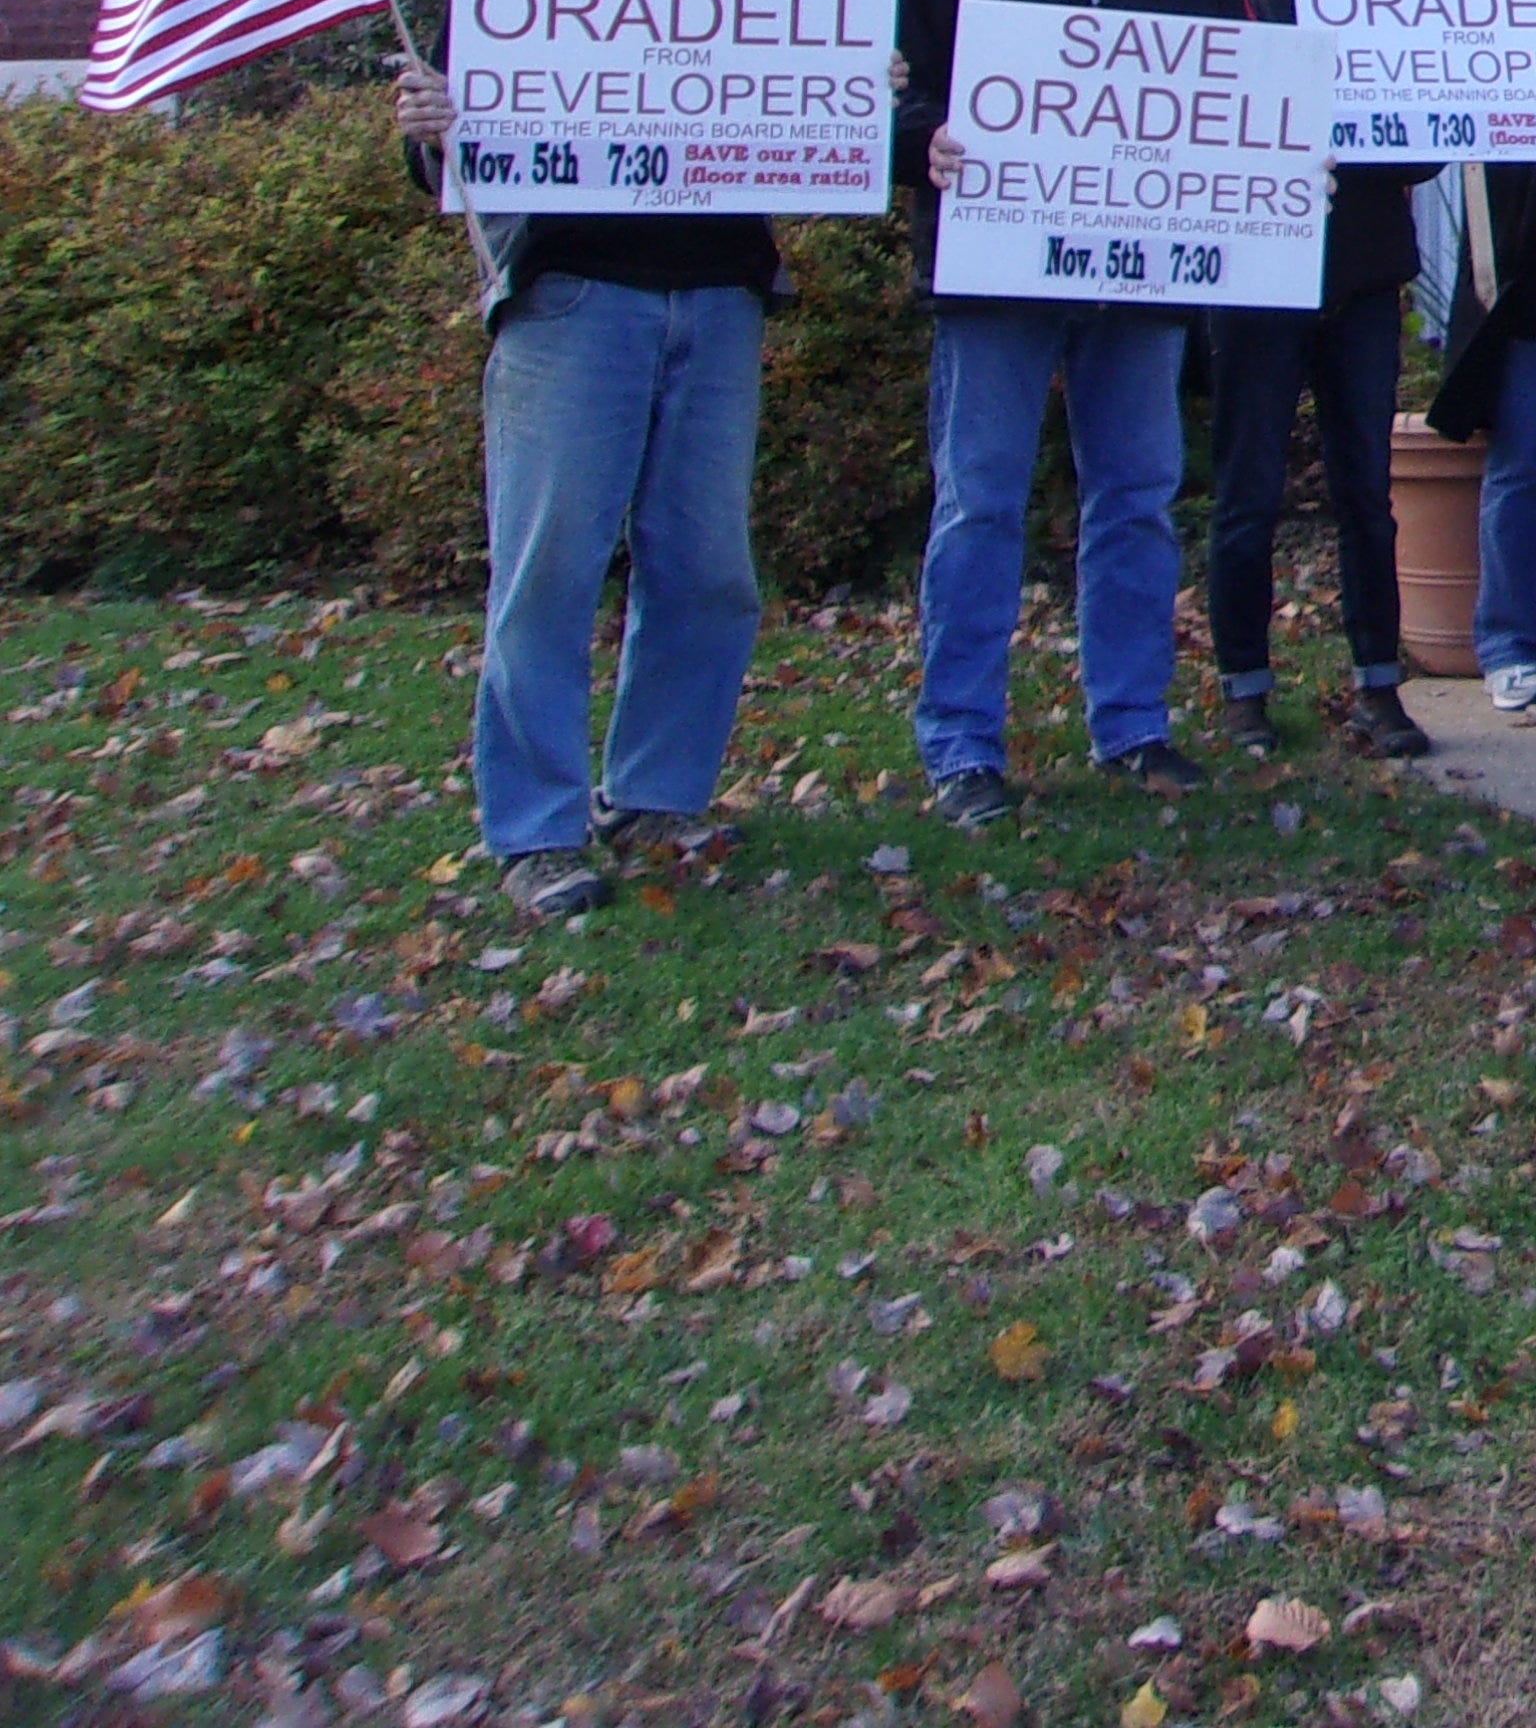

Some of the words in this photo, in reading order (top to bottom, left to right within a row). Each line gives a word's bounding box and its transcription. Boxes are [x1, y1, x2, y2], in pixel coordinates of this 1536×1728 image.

[1059, 14, 1241, 80] SAVE
[1442, 30, 1495, 45] FROM
[643, 47, 712, 67] FROM
[463, 68, 876, 118] DEVELOPERS
[1381, 88, 1413, 101] THE
[1418, 88, 1499, 101] PLANNING
[969, 75, 1312, 152] ORADELL
[1488, 114, 1536, 128] SAVE
[458, 120, 544, 138] ATTEND
[549, 121, 591, 138] THE
[599, 122, 706, 140] PLANNING
[711, 123, 784, 140] BOARD
[789, 124, 879, 141] MEETING
[1330, 120, 1364, 148] ov.
[1371, 112, 1408, 147] 5th
[1427, 113, 1476, 148] 7:30
[458, 141, 520, 185] Nov.
[531, 140, 579, 185] 5th
[608, 143, 669, 187] 7:30
[684, 144, 750, 162] SAVE
[757, 149, 796, 163] our
[802, 146, 871, 164] F.A.R.
[1111, 144, 1171, 162] FROM
[683, 167, 748, 187] (floor
[754, 171, 801, 186] area
[809, 168, 871, 188] ratio)
[956, 159, 1312, 218] DEVELOPERS
[950, 206, 1025, 223] ATTEND
[1032, 209, 1066, 226] THE
[1070, 212, 1162, 232] PLANNING
[1167, 218, 1229, 234] BOARD
[1234, 220, 1314, 239] MEETING
[1044, 236, 1096, 279] Nov.
[1105, 239, 1145, 280] 5th
[1169, 243, 1221, 285] 7:30
